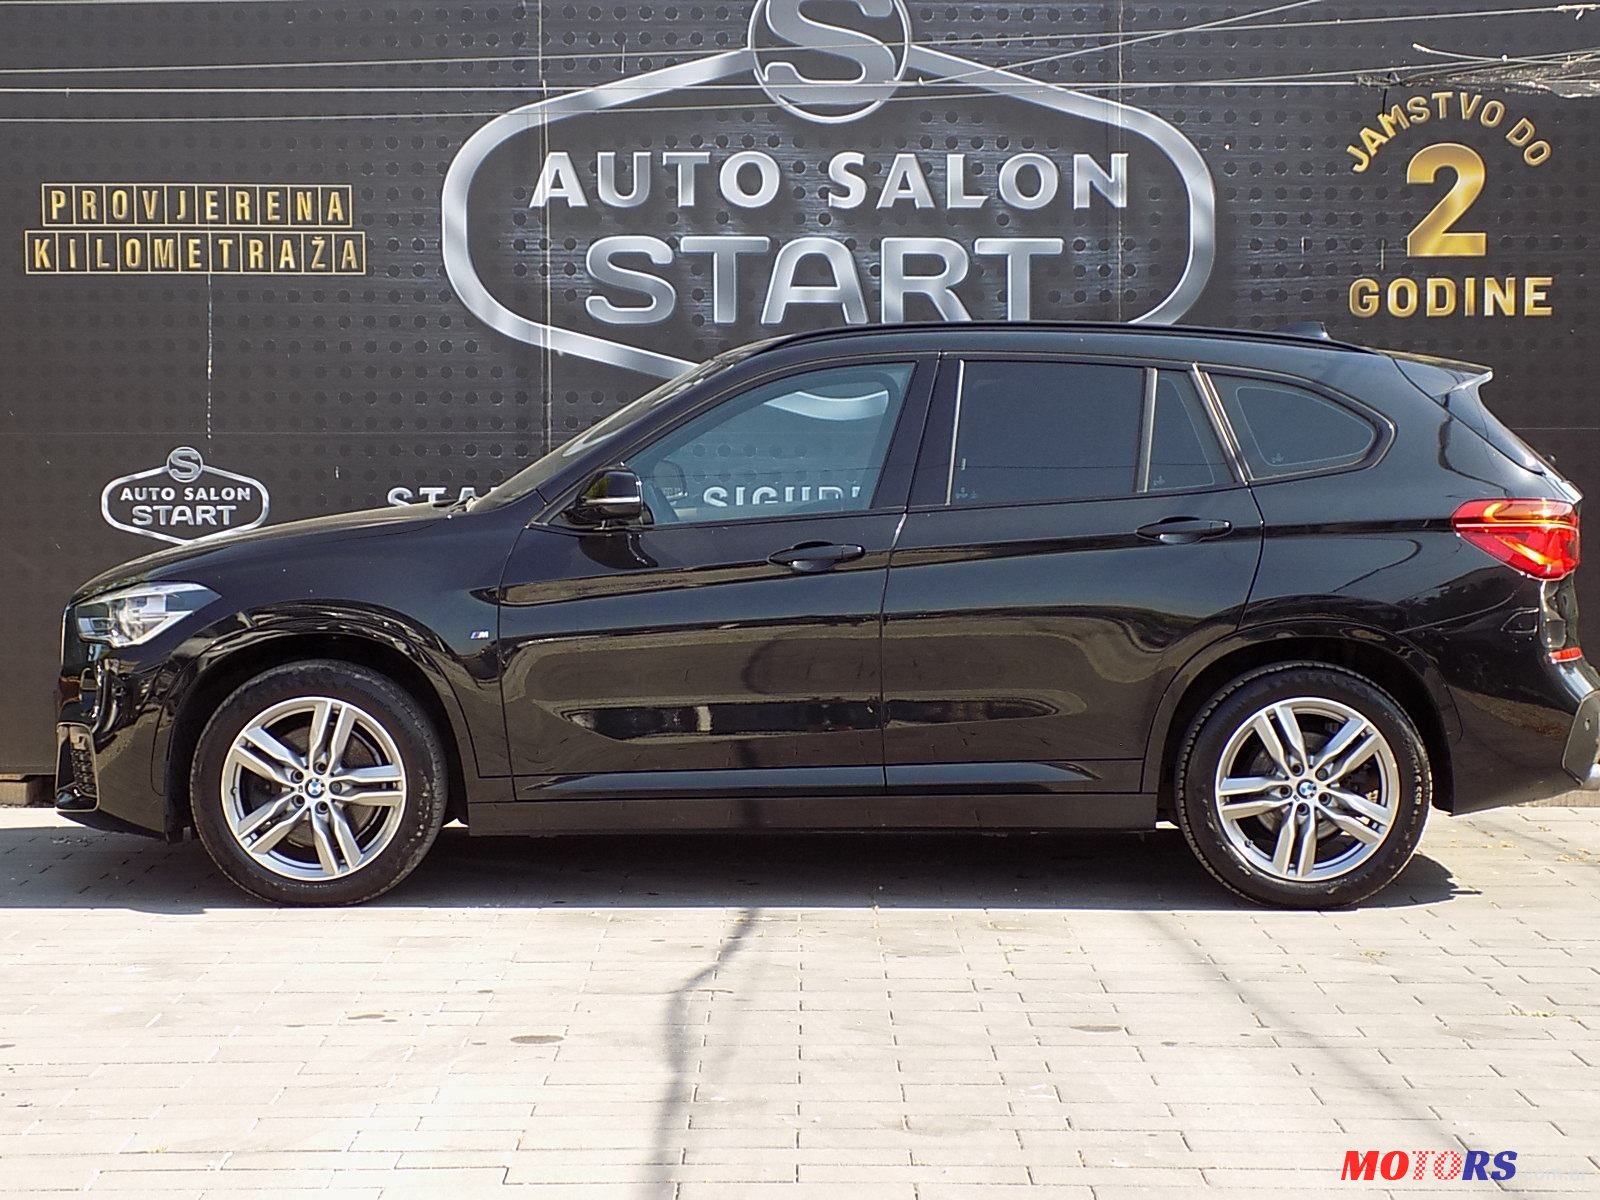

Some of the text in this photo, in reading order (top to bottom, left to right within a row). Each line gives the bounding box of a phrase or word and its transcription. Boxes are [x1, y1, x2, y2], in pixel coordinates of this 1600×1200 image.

[766, 0, 896, 105] S
[1346, 91, 1552, 173] JAMSTVO DO
[528, 151, 1130, 209] AUTO SALON
[1406, 142, 1487, 257] 2
[50, 189, 345, 221] PROVJERENA
[33, 235, 358, 270] KILOMETRAŽA
[584, 235, 1065, 325] START
[1349, 276, 1553, 318] GODINE
[170, 450, 200, 479] S
[120, 487, 251, 501] AUTO SALON
[131, 505, 237, 526] START
